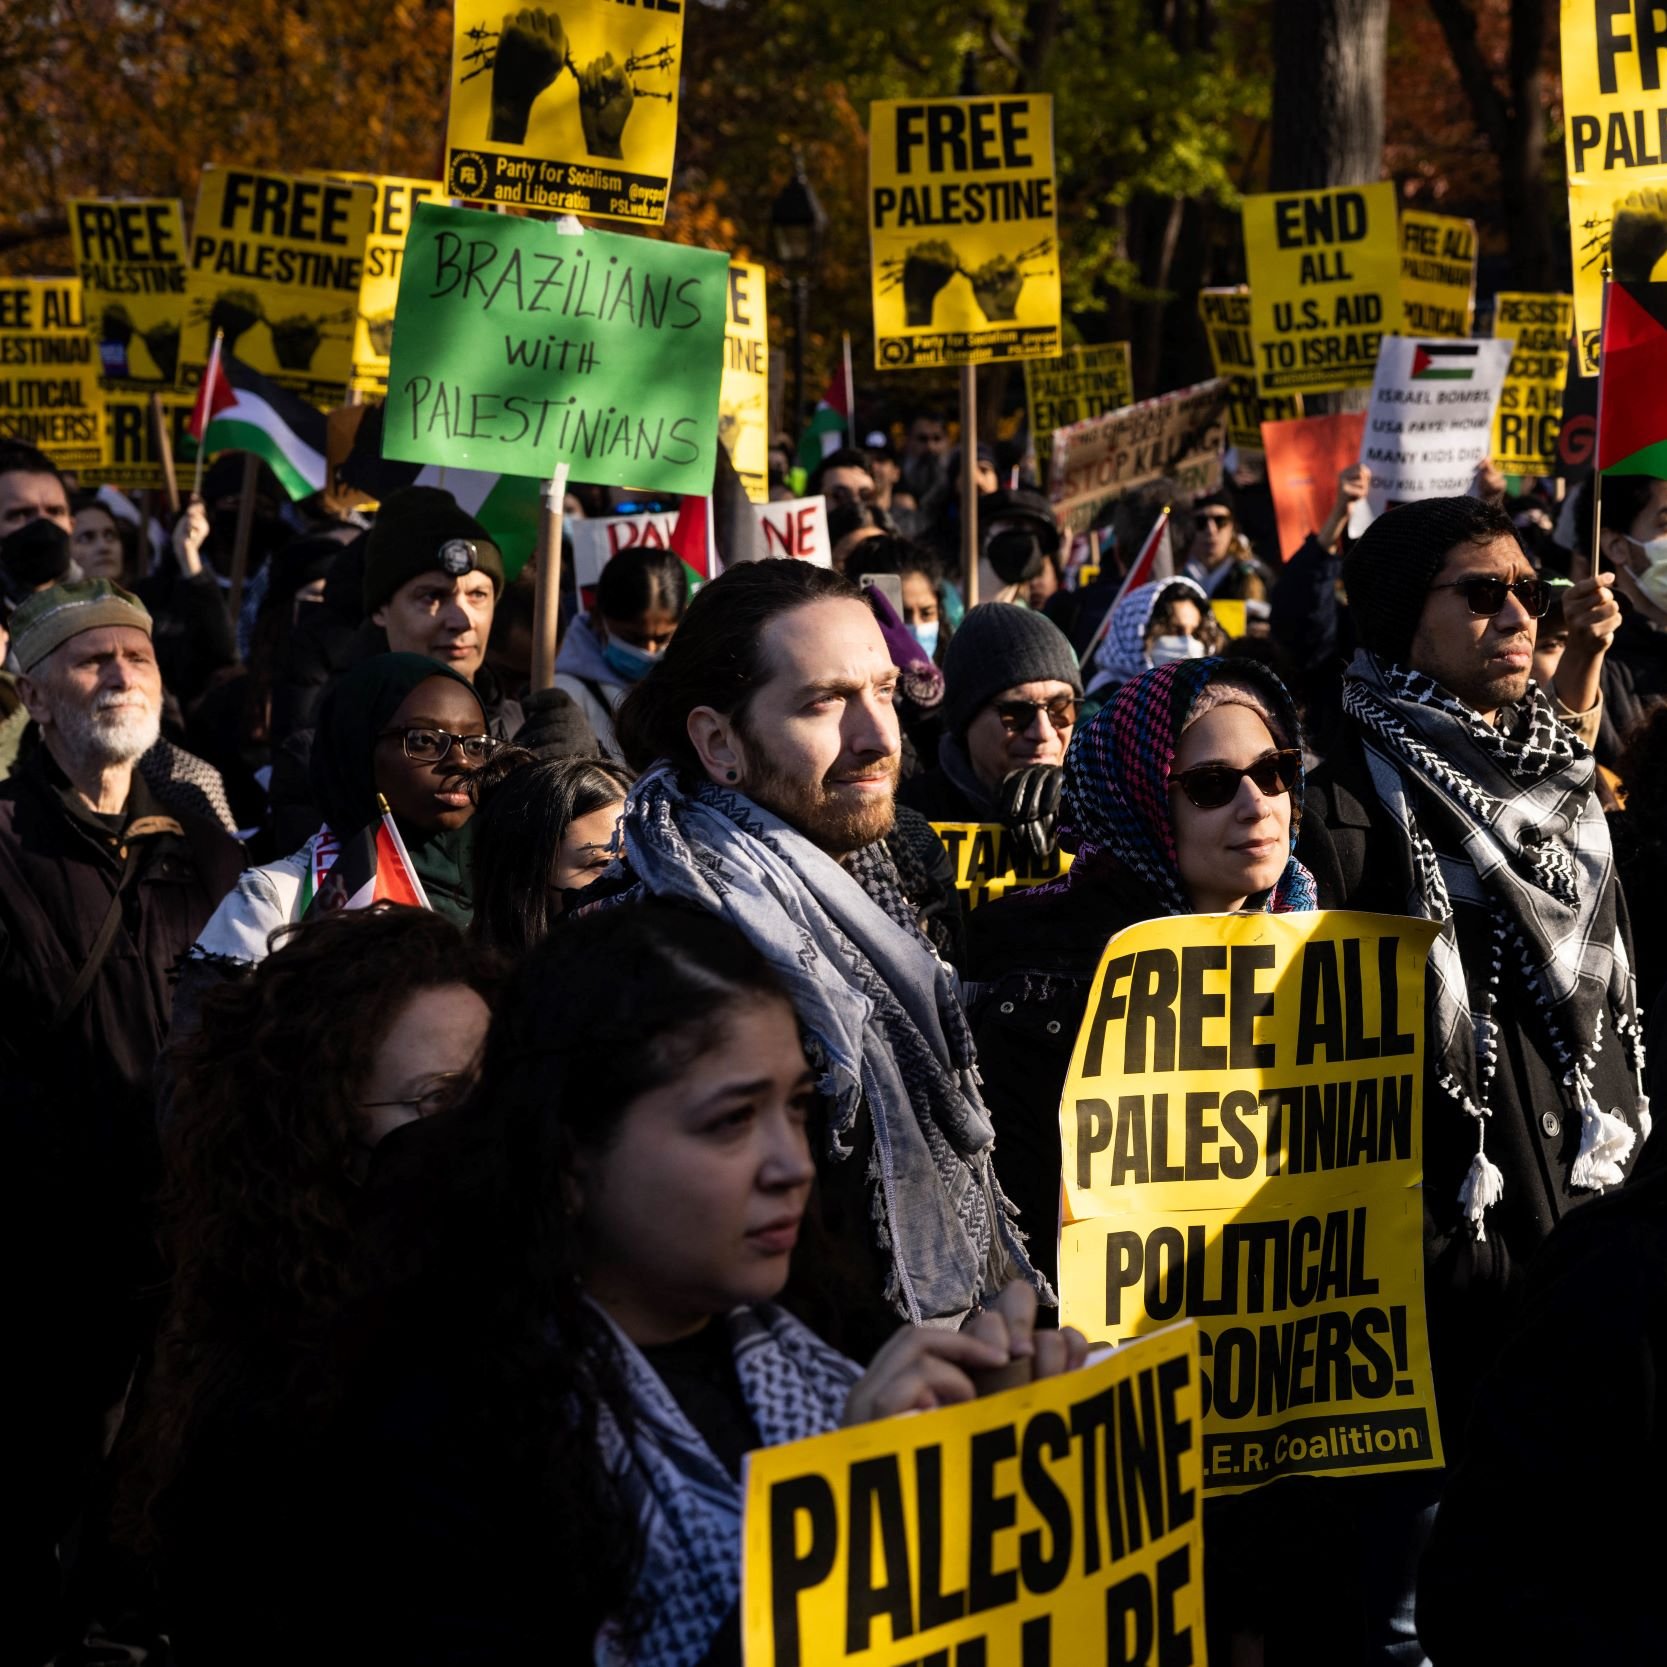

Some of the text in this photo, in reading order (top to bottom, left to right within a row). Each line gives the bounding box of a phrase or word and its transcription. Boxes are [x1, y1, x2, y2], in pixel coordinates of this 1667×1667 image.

[896, 101, 1033, 174] FREE
[494, 183, 522, 201] and
[497, 157, 535, 183] Party
[539, 167, 564, 184] for
[567, 166, 622, 192] Socialism
[220, 173, 352, 246] FREE
[874, 179, 1053, 228] PALESTINE
[1275, 191, 1368, 251] END
[77, 204, 178, 262] FREE
[80, 262, 188, 294] PALESTINE
[192, 235, 362, 293] PALESTINE
[1301, 251, 1353, 286] ALL
[1272, 293, 1383, 333] U.S. AID
[1260, 330, 1384, 369] TO ISRAE
[1377, 388, 1431, 405] ISRAEL
[1372, 419, 1402, 433] USA
[1367, 447, 1414, 464] MANY
[1366, 477, 1393, 491] OU
[1081, 937, 1415, 1079] FREE ALL
[1075, 1074, 1414, 1191] PALESTINIAN
[1105, 1207, 1380, 1327] POLITICAL
[1274, 1424, 1419, 1462] Coalition
[770, 1354, 1196, 1667] PALESTINE
